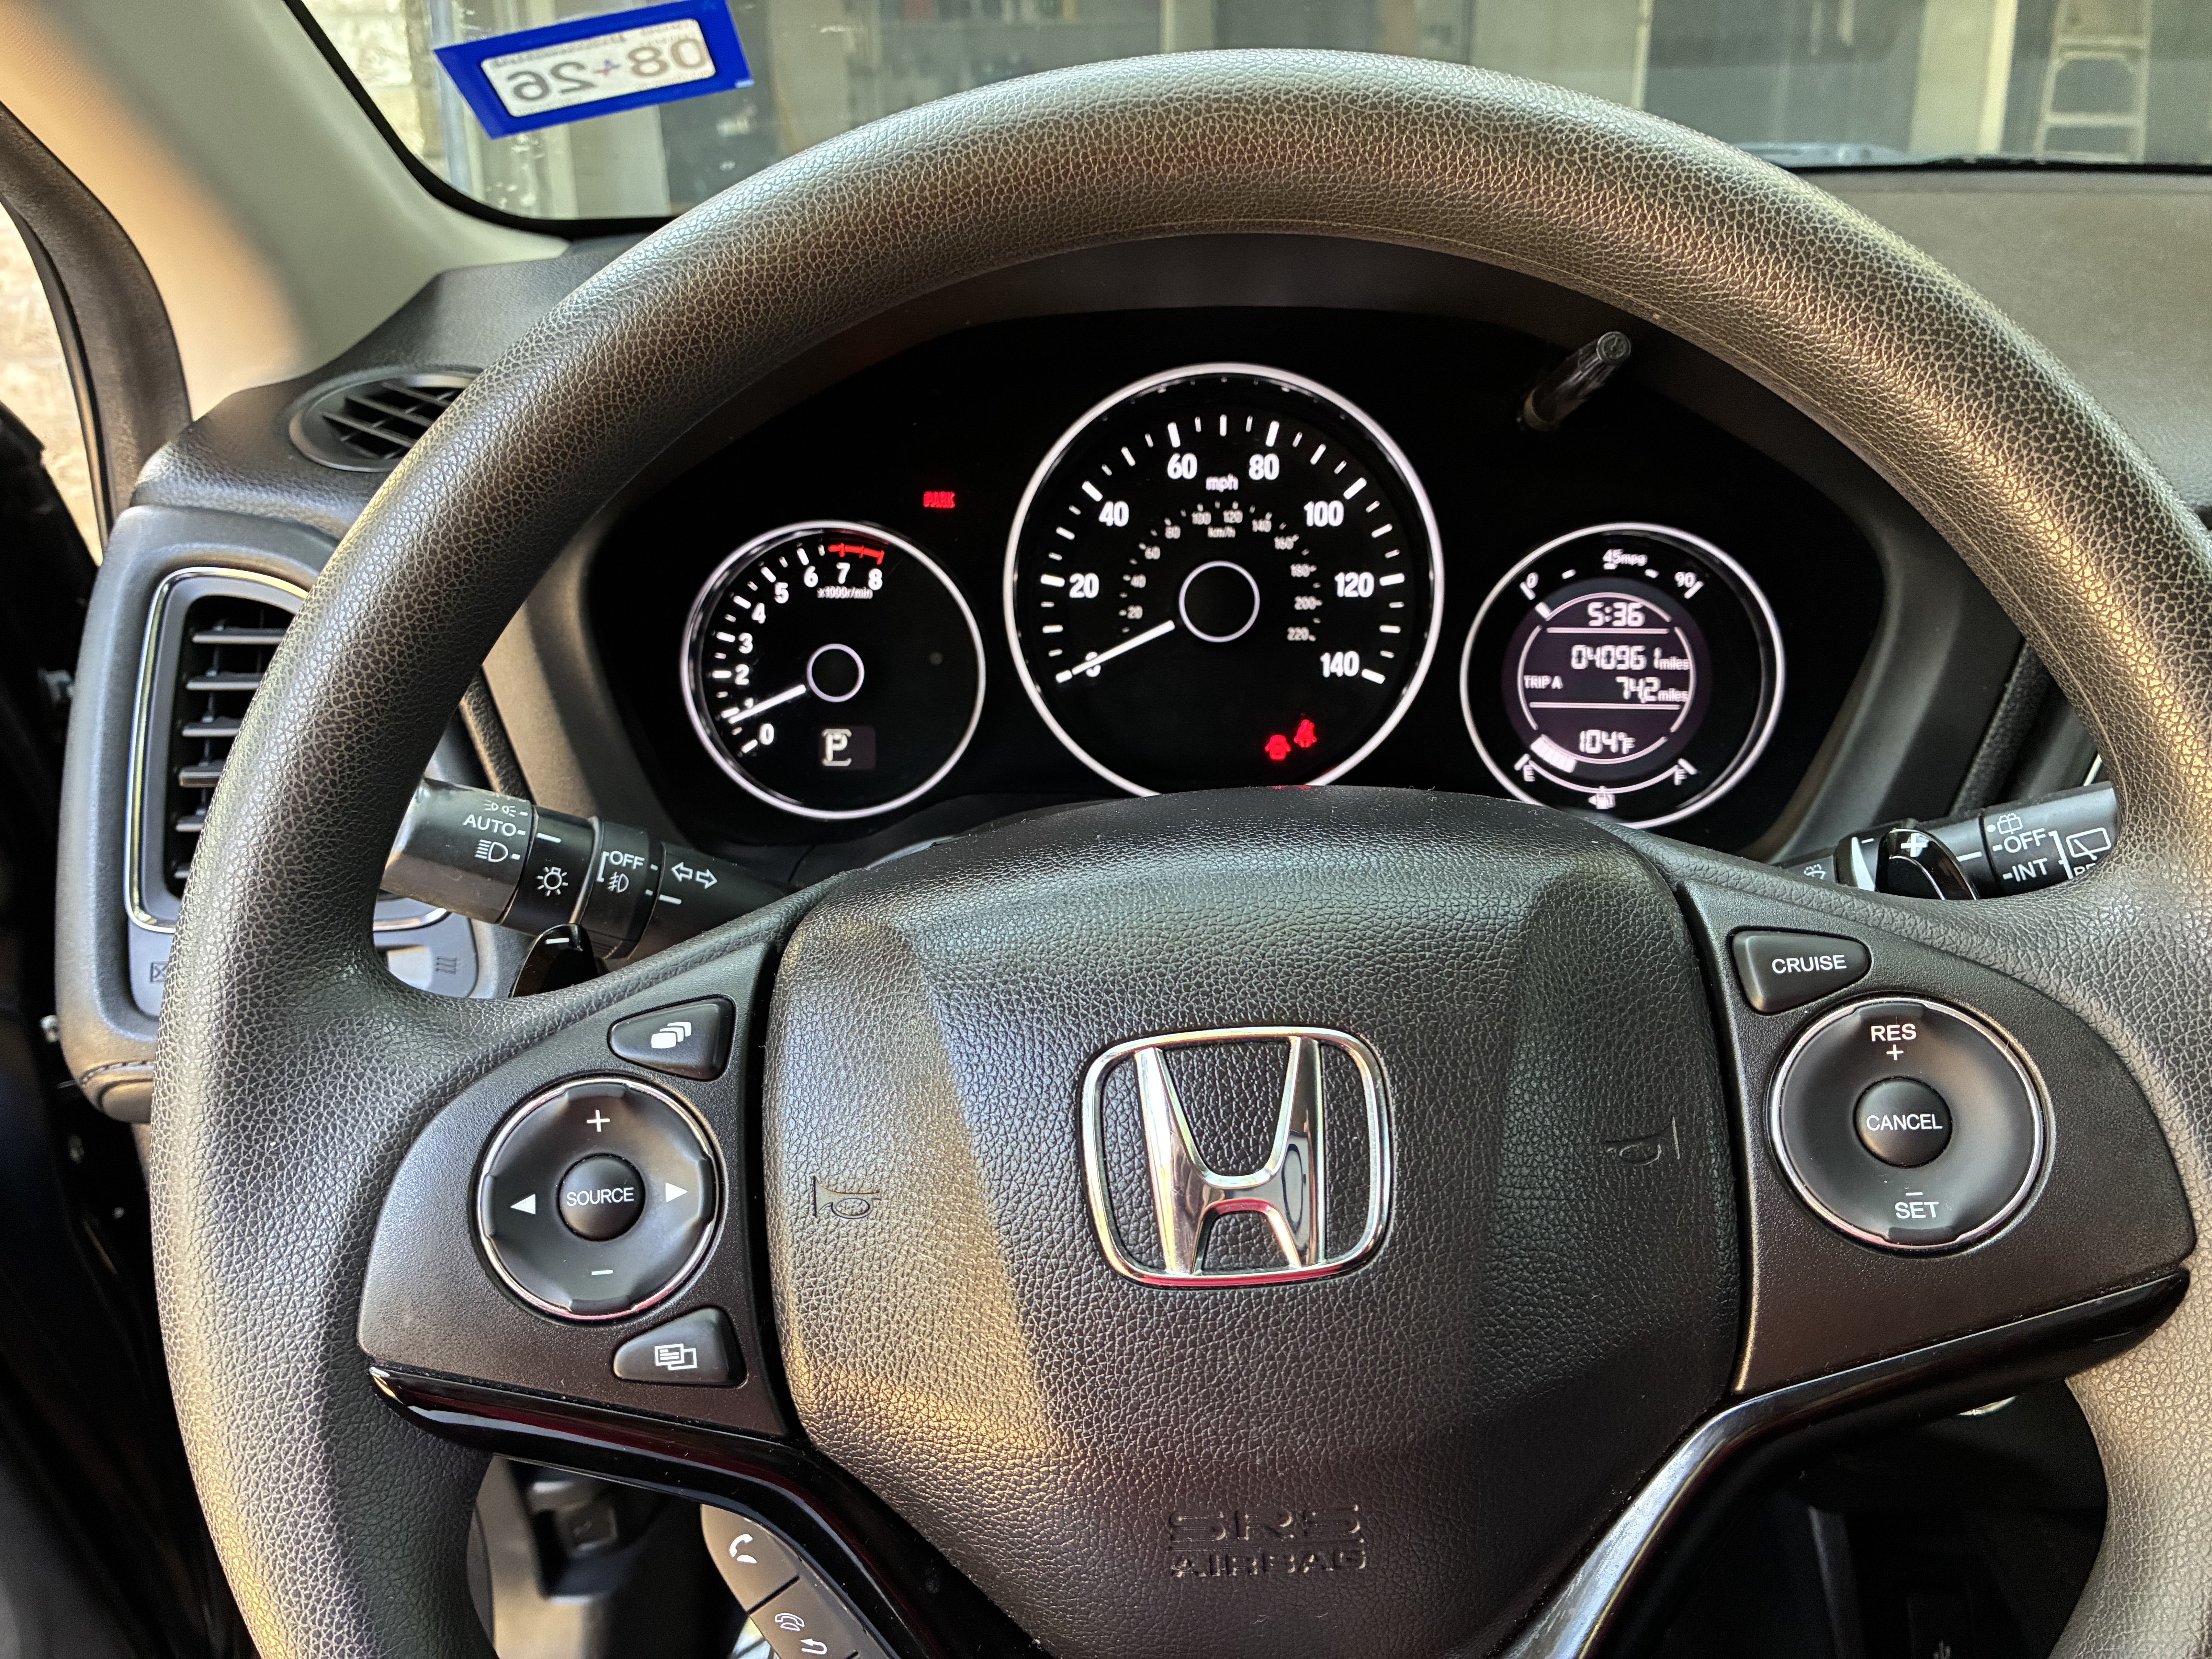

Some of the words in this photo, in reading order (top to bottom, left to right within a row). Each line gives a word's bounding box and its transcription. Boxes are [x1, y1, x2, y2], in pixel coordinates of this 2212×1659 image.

[1167, 453, 1197, 479] 60
[1249, 453, 1279, 480] 80
[1206, 474, 1238, 492] mph
[1099, 501, 1129, 527] 40
[1223, 510, 1243, 524] 120
[1304, 500, 1344, 527] 100
[1165, 525, 1181, 539] 80
[1144, 546, 1161, 560] 60
[804, 566, 818, 587] 6
[836, 562, 850, 584] 7
[868, 568, 883, 591] 8
[1130, 574, 1146, 588] 40
[1527, 572, 1539, 589] 0
[1674, 572, 1696, 588] 90
[775, 582, 789, 604] 5
[1069, 573, 1099, 599] 20
[1334, 572, 1375, 598] 120
[751, 603, 766, 624] 4
[1127, 605, 1143, 619] 20
[1294, 596, 1316, 610] 200
[1588, 602, 1645, 627] 5:36
[738, 632, 753, 654] 3
[1287, 627, 1309, 641] 220
[1320, 651, 1360, 678] 140
[1659, 656, 1689, 670] miles
[735, 663, 750, 685] 2
[1523, 675, 1551, 689] TRIP
[1551, 675, 1563, 689] A
[1658, 688, 1688, 702] miles
[759, 723, 775, 745] 0
[825, 732, 848, 762] P
[1523, 764, 1536, 782] E
[1674, 769, 1687, 786] F
[463, 814, 516, 836] AUTO
[2004, 828, 2046, 853] OFF
[610, 850, 645, 869] OFF
[2012, 857, 2047, 882] INT
[1771, 954, 1847, 974] CRUISE
[1871, 1023, 1917, 1042] RES
[1866, 1114, 1943, 1131] CANCEL
[566, 1186, 634, 1207] SOURCE
[1895, 1201, 1939, 1219] SET
[1169, 1510, 1360, 1543] SRS
[1171, 1551, 1366, 1577] AIRBAG
